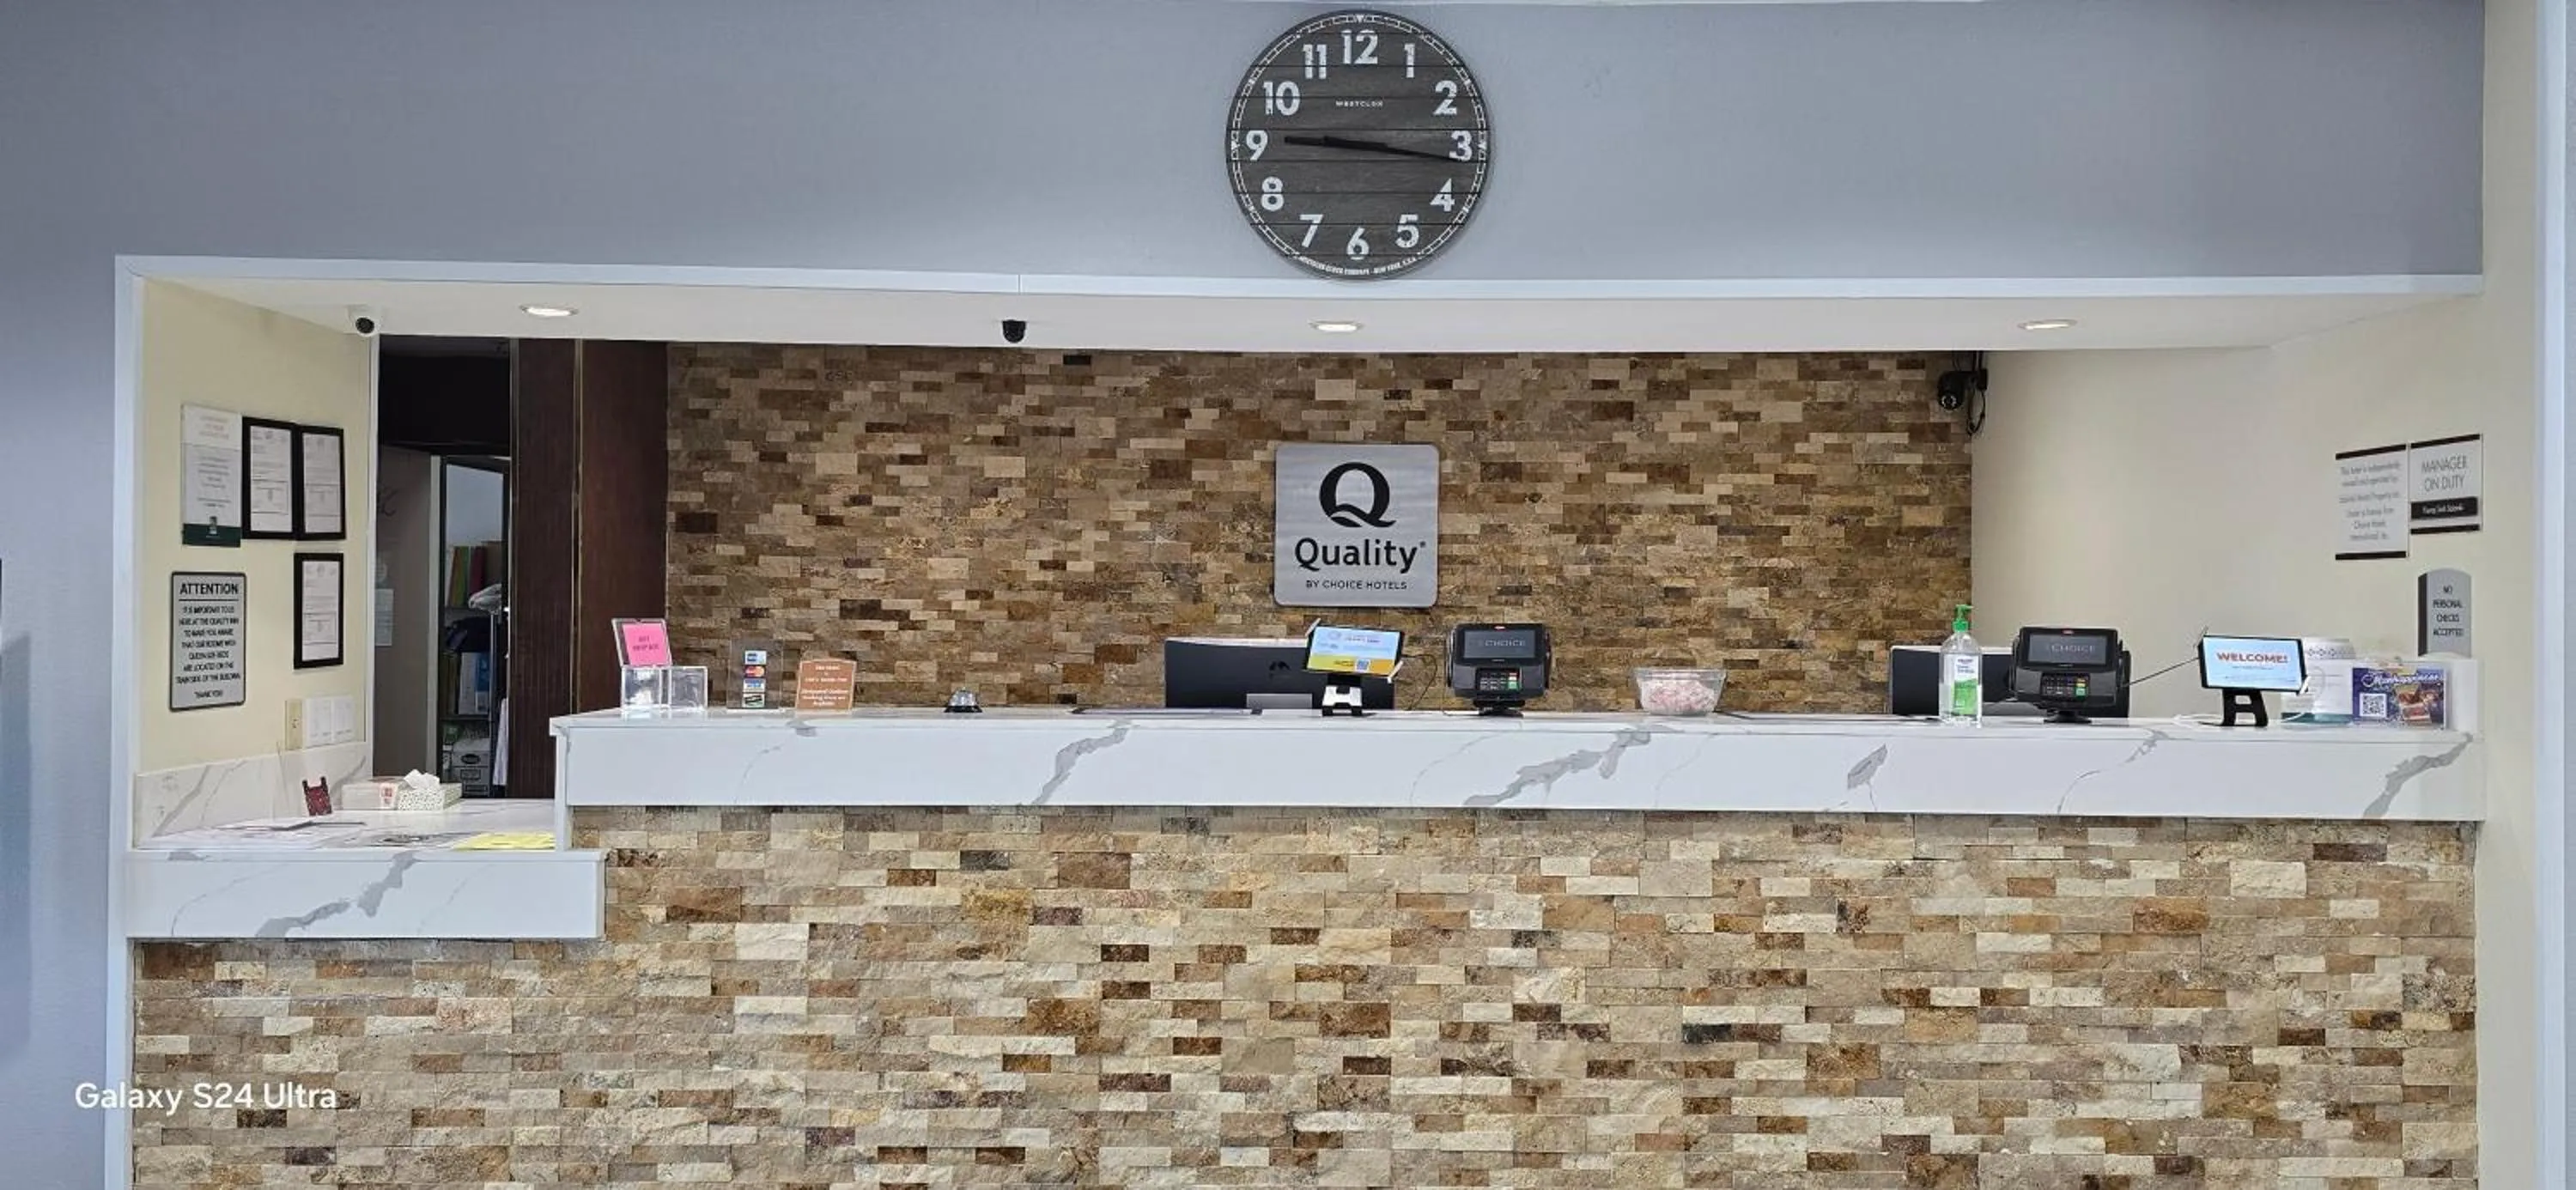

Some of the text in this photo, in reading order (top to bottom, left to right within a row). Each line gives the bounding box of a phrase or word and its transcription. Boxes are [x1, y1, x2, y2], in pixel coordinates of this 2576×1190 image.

[1303, 44, 1327, 79] 11
[1341, 29, 1378, 64] 12
[1404, 44, 1415, 78] 1
[1263, 82, 1300, 115] 10
[1433, 81, 1457, 114] 2
[1246, 131, 1268, 161] 9
[1449, 131, 1473, 161] 3
[1261, 177, 1284, 211] 8
[1430, 178, 1455, 212] 4
[1299, 215, 1323, 247] 7
[1346, 227, 1370, 259] 6
[1395, 215, 1419, 248] 5
[2421, 455, 2466, 473] MANAGER
[2424, 474, 2465, 492] ON DUTY
[179, 583, 239, 595] ATTENTION
[1306, 580, 1407, 590] BY CHOICE HOTELS
[2216, 652, 2288, 664] WELCOME!
